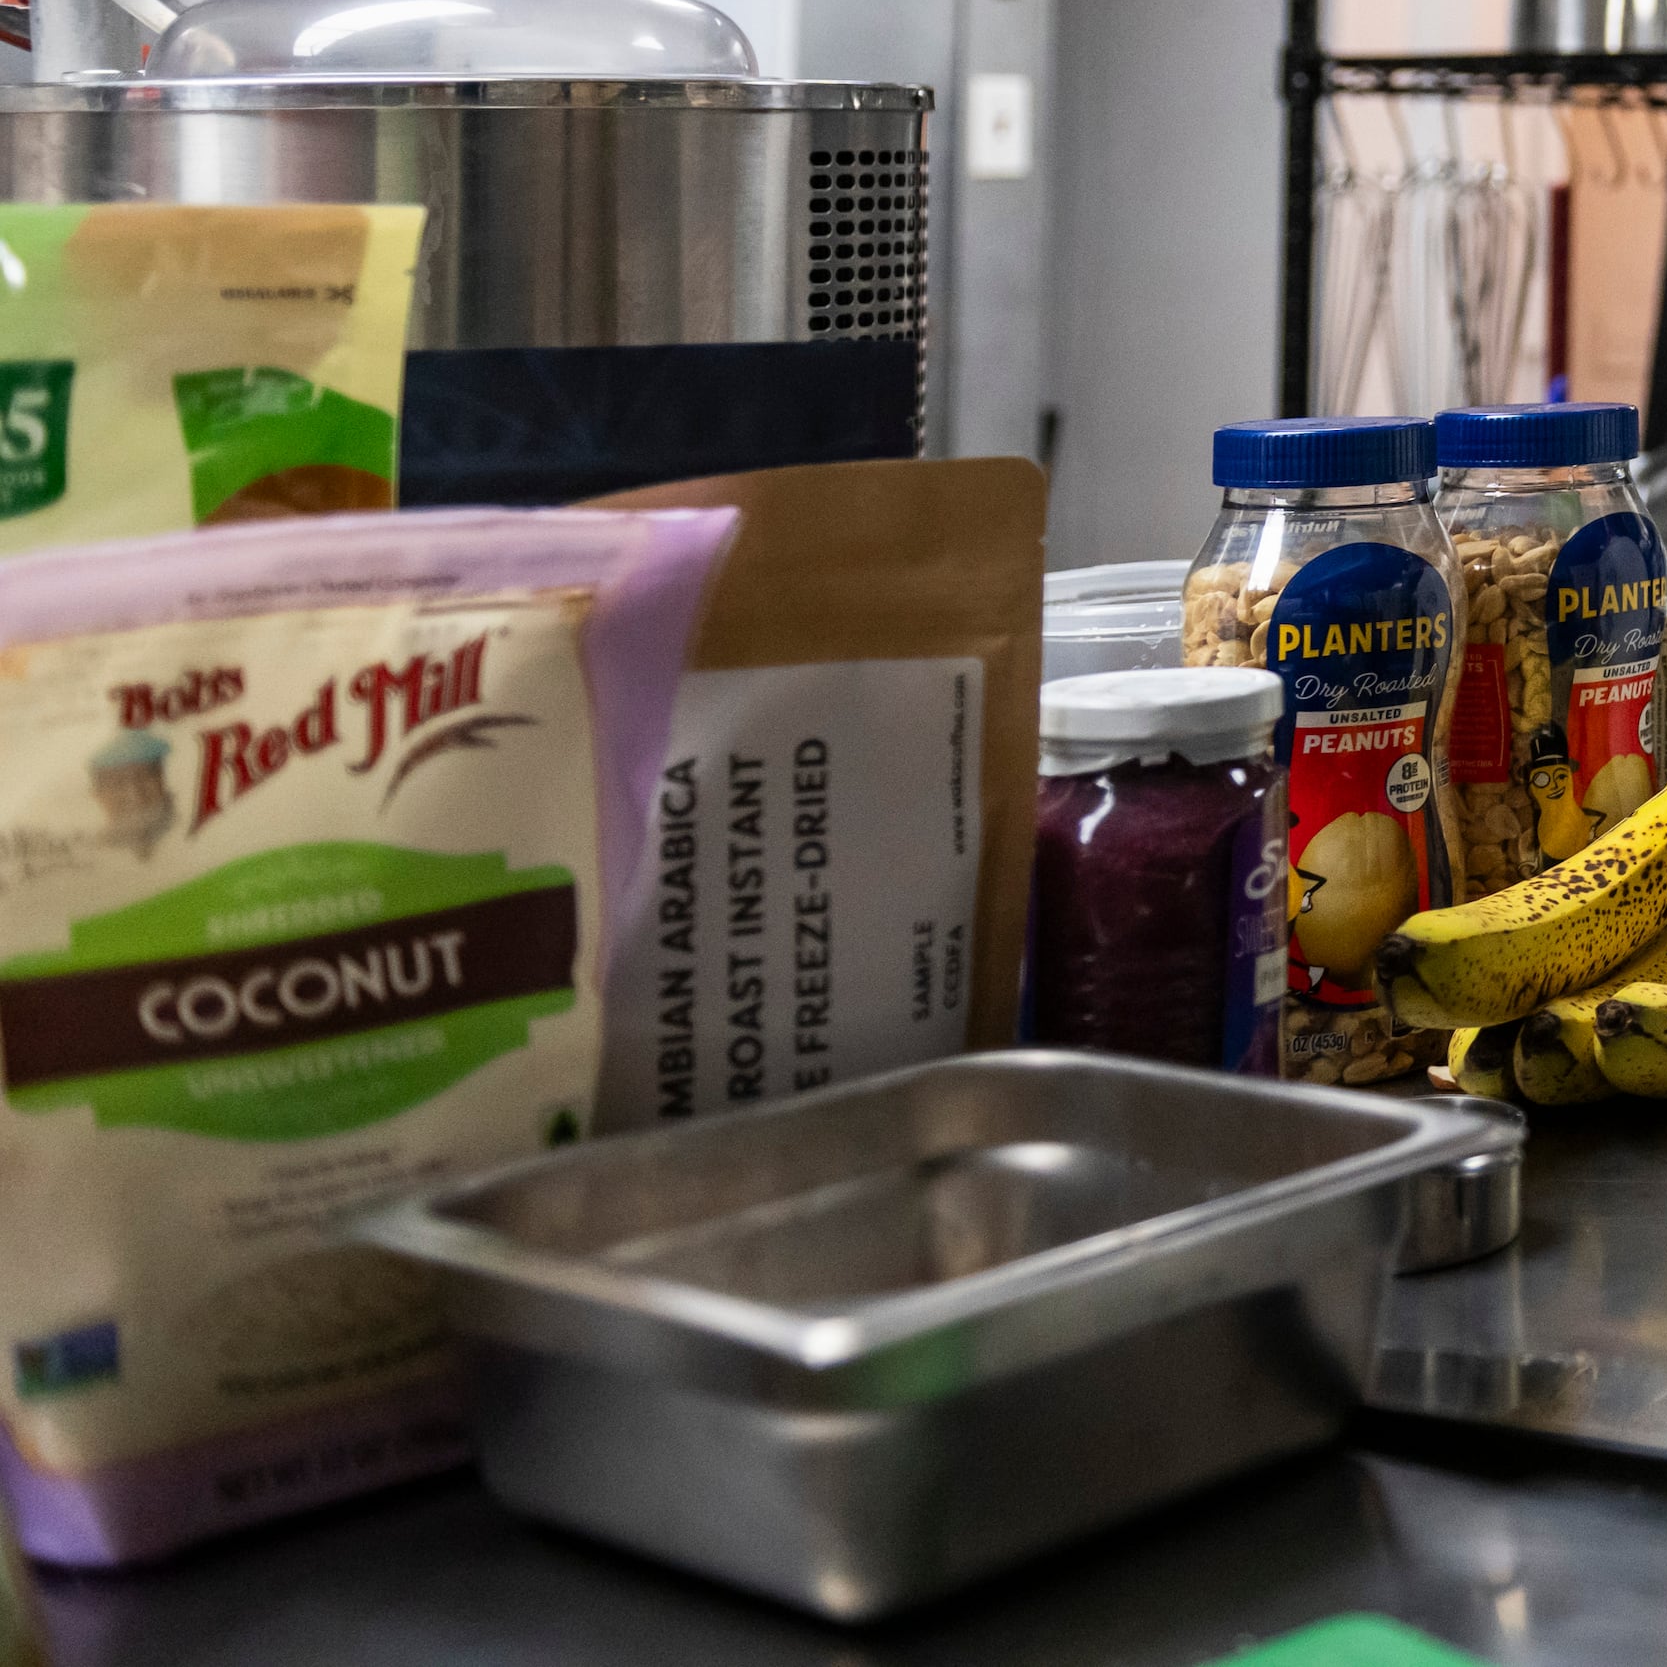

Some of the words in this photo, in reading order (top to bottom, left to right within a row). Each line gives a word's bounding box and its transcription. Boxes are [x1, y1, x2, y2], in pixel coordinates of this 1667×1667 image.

[0, 387, 51, 462] 5
[1278, 612, 1447, 661] PLANTERS
[1574, 634, 1620, 664] Dry
[1295, 675, 1350, 709] Dry
[1353, 663, 1438, 698] Roasted
[1603, 661, 1650, 678] UNSALTED
[188, 677, 339, 837] Red
[347, 634, 489, 775] Mill
[1303, 726, 1416, 754] PEANUTS
[1330, 708, 1401, 725] UNSALTED
[1390, 778, 1428, 795] PROTEIN
[658, 757, 697, 954] ARABICA
[728, 752, 764, 938] INSTANT
[794, 737, 831, 1055] FREEZE-DRIED
[137, 932, 468, 1042] COCONUT
[912, 919, 935, 1022] SAMPLE
[727, 955, 764, 1101] ROAST
[1293, 1037, 1308, 1053] OZ
[1312, 1031, 1347, 1053] (453g)
